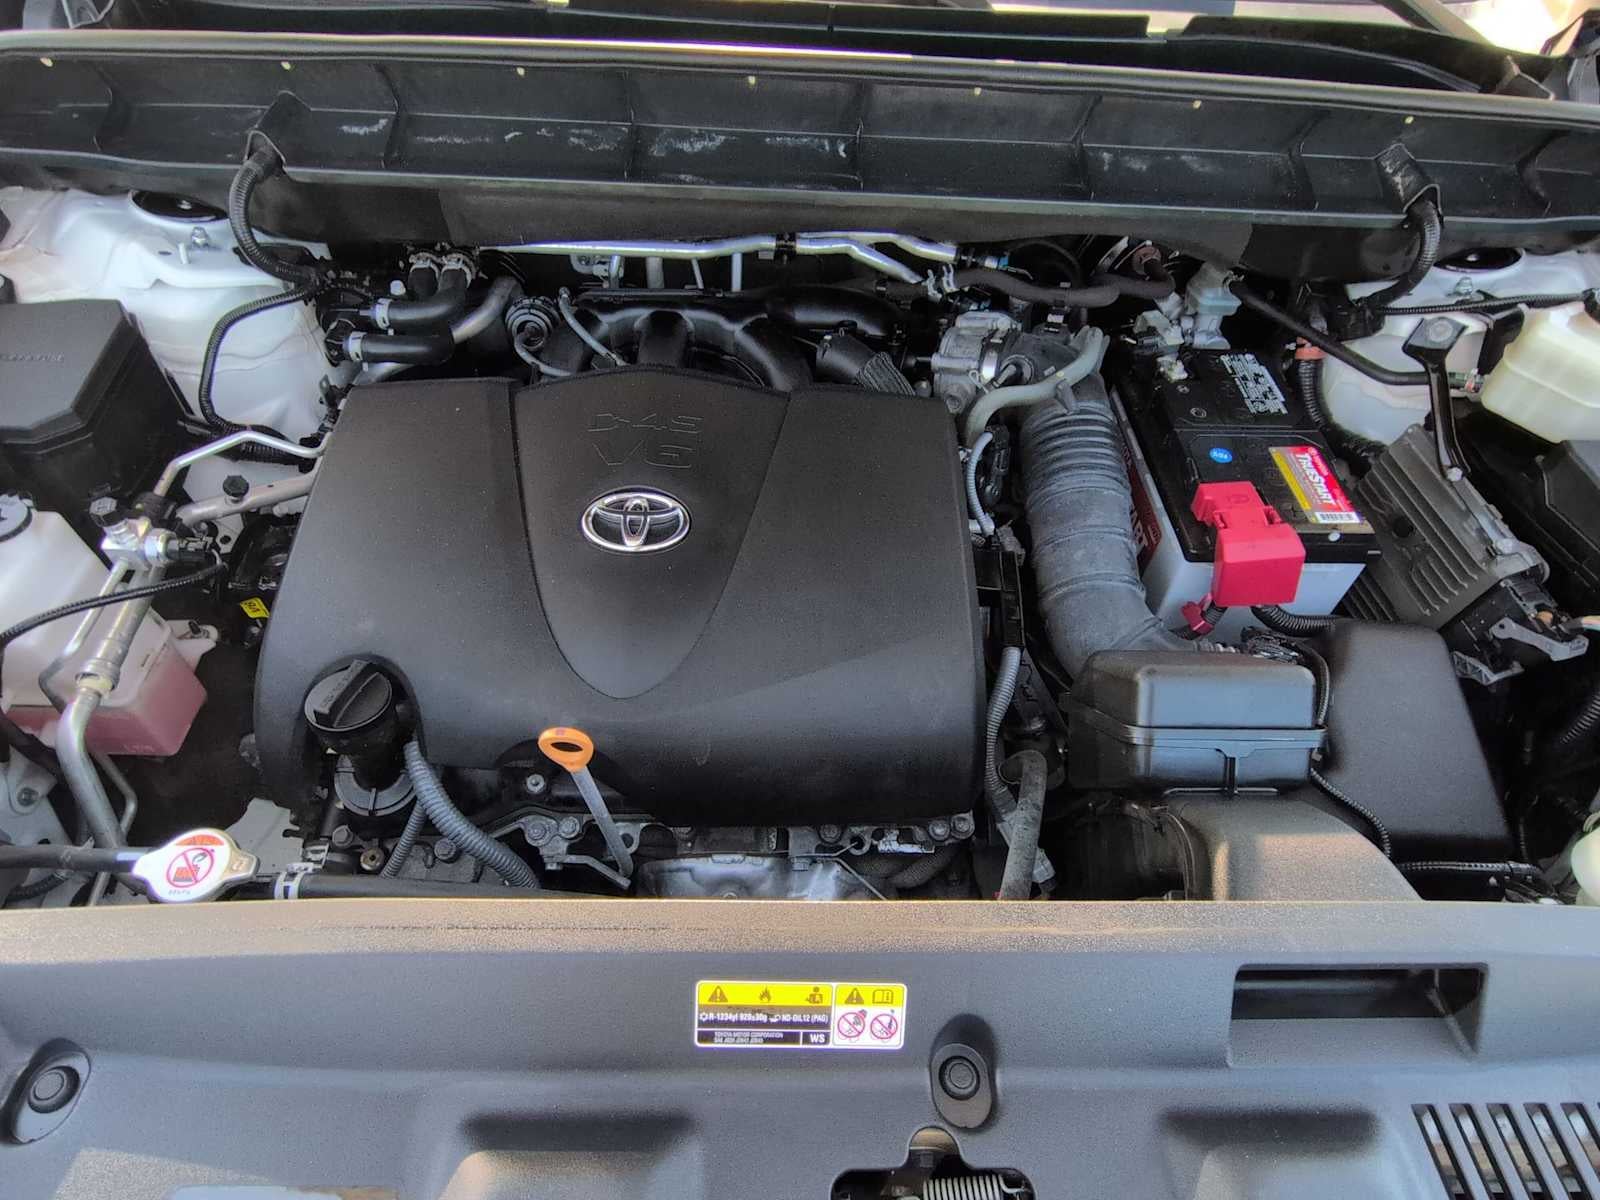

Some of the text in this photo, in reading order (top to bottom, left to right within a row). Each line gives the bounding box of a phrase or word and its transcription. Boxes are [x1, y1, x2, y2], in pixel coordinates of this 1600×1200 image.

[587, 412, 704, 434] D-4S
[591, 440, 697, 469] V6
[809, 1032, 826, 1044] WS
